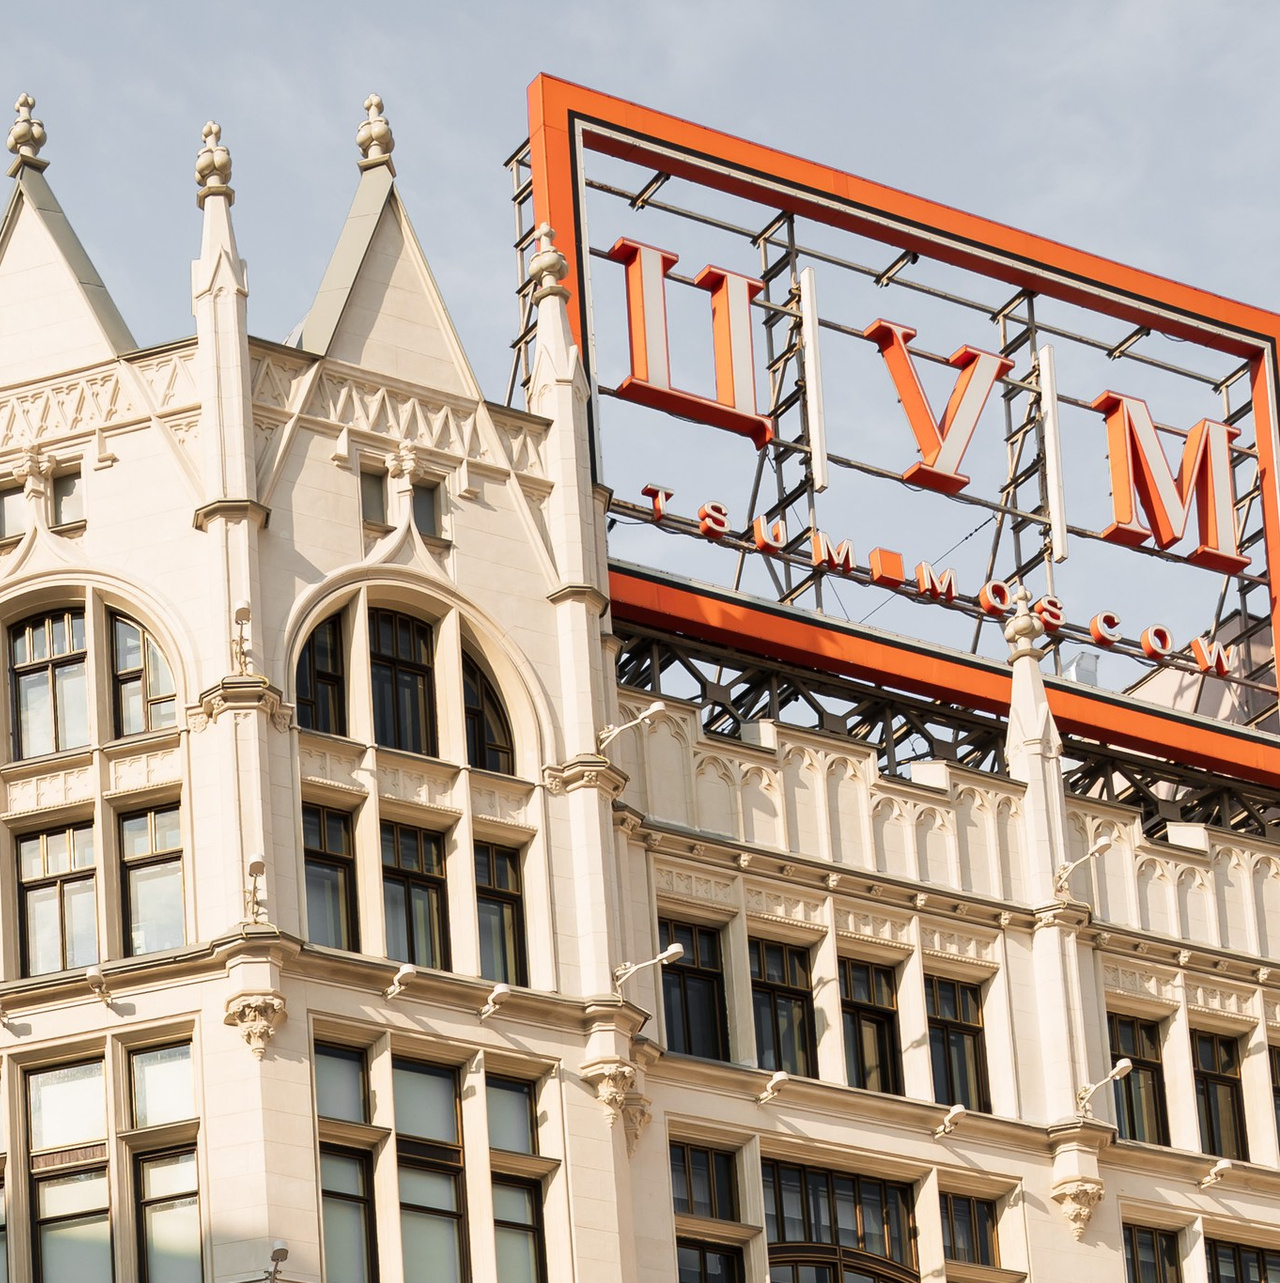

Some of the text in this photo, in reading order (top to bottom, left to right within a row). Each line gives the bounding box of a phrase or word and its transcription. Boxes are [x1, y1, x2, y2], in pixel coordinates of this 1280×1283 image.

[608, 236, 1252, 575] ЦУМ
[641, 484, 1238, 677] TSUM MOSCOW
